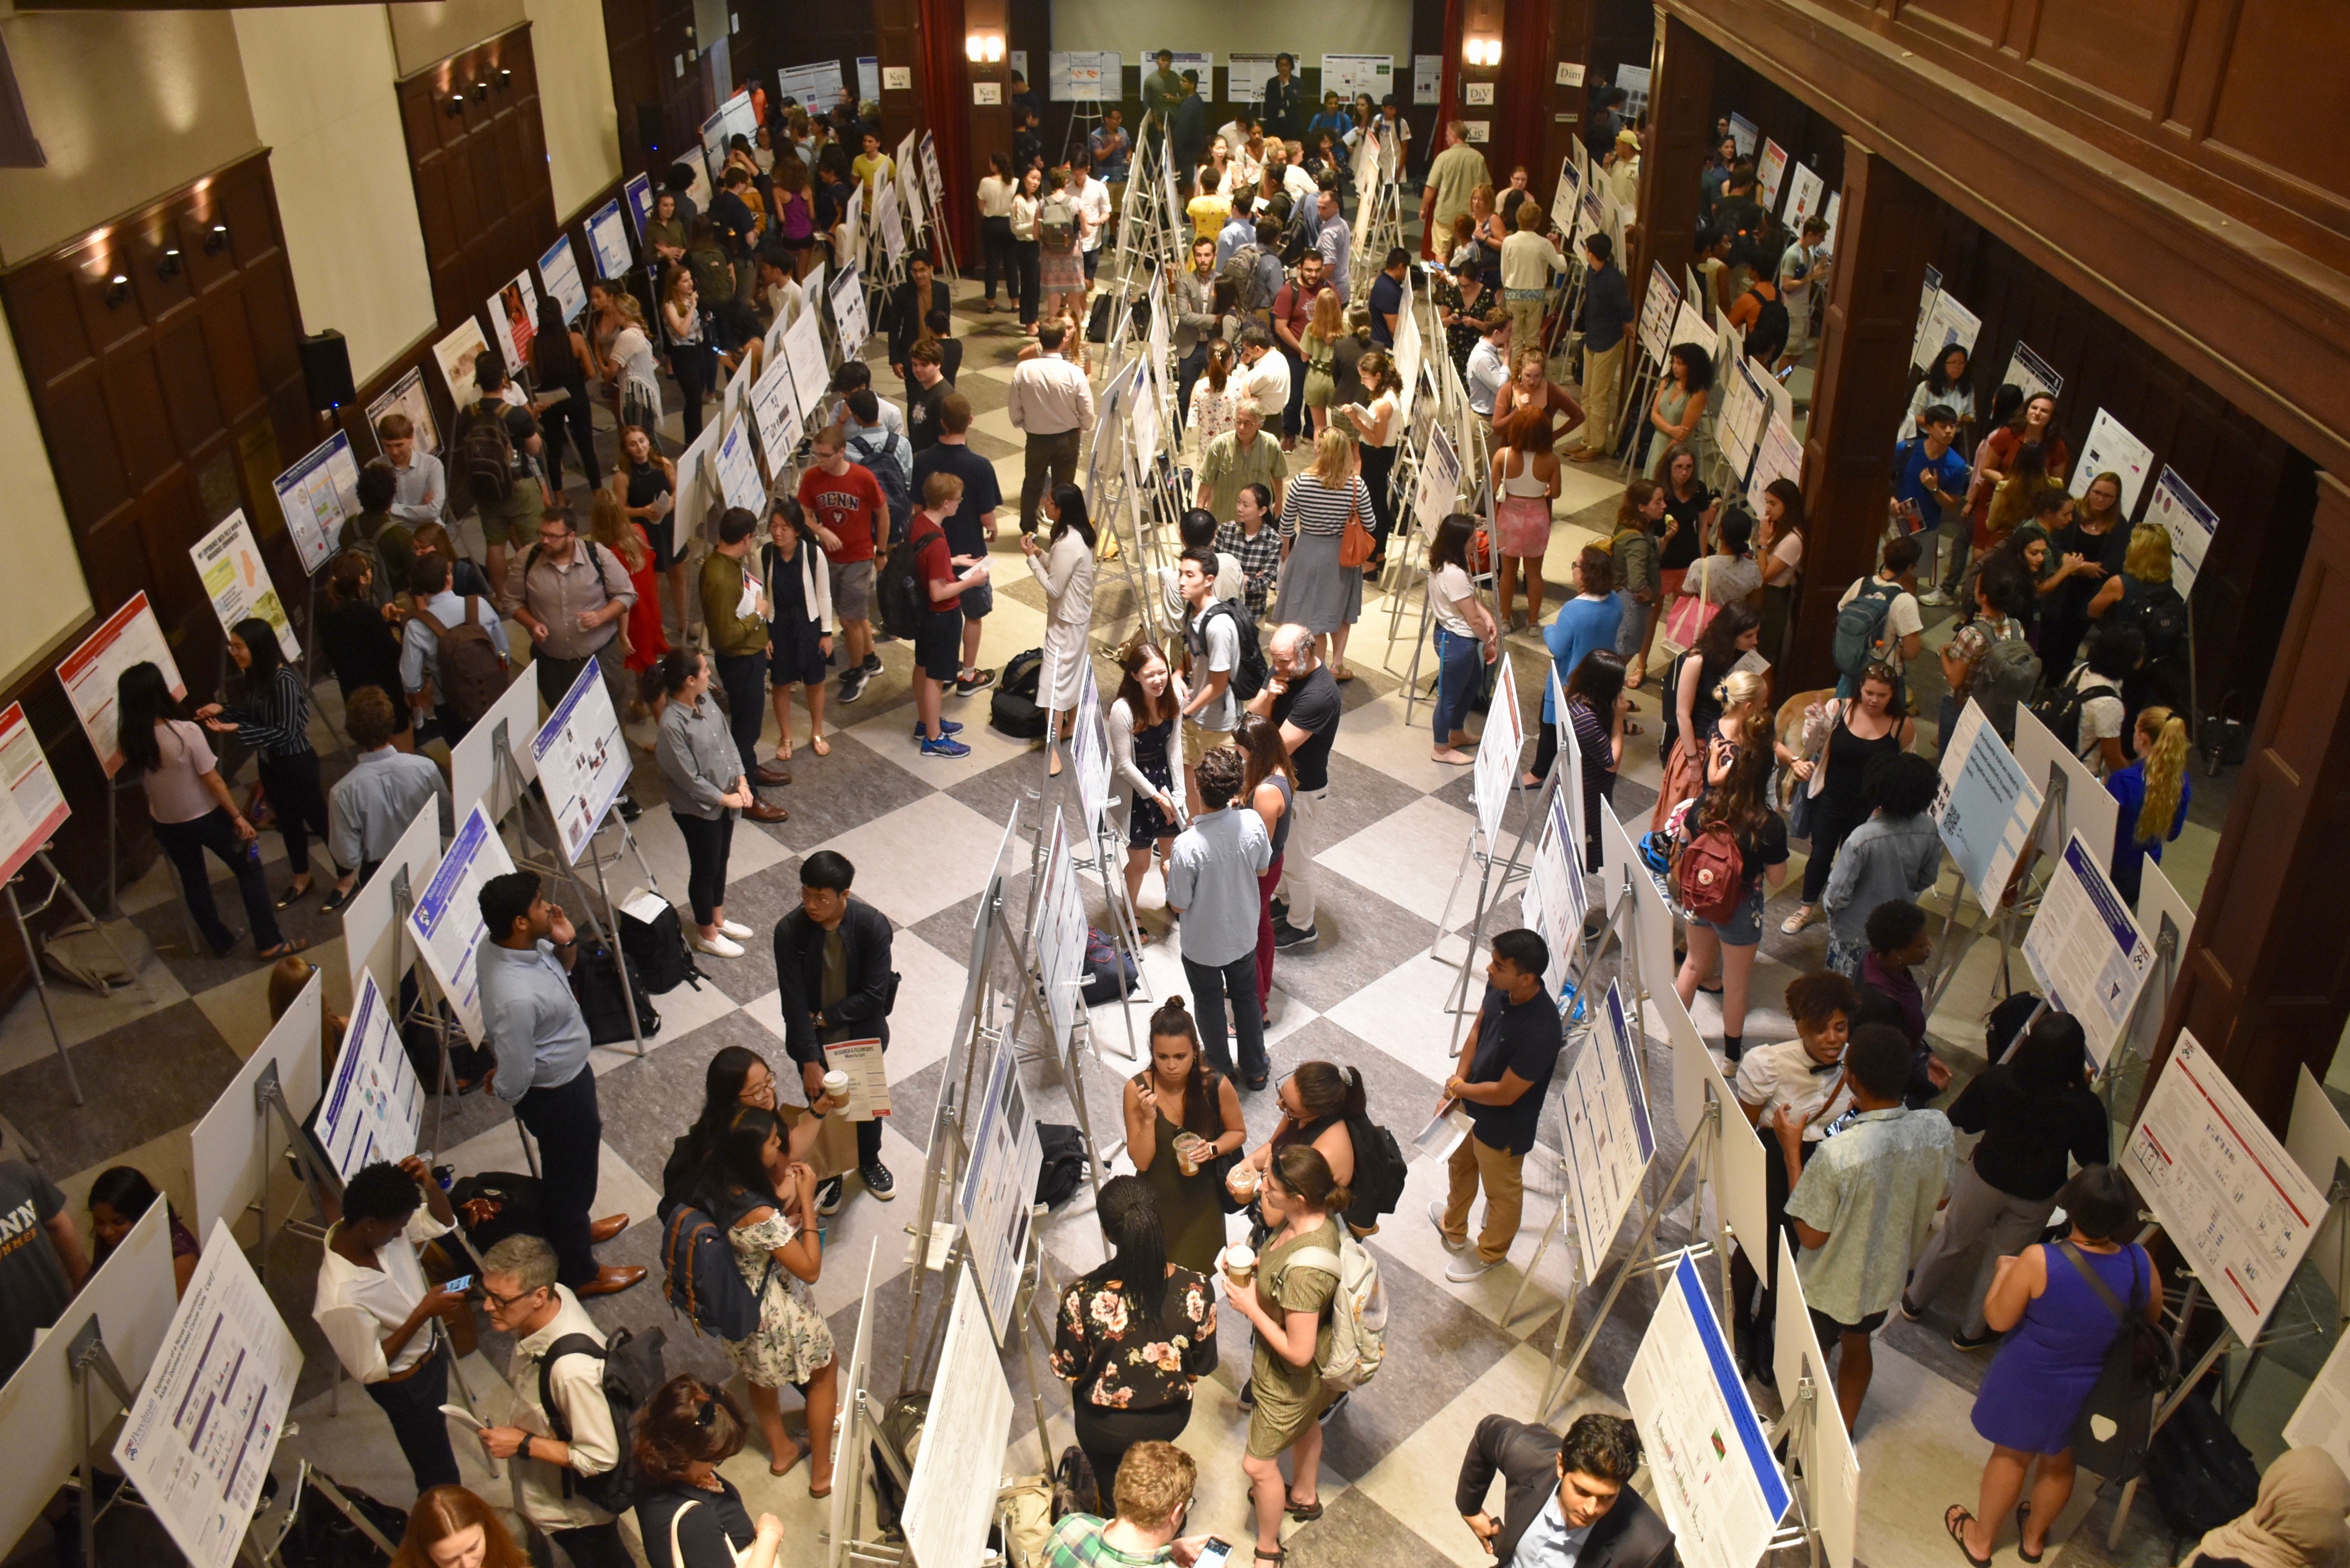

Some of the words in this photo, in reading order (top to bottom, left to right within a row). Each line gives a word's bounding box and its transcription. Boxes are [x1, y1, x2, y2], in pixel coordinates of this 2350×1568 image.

[1560, 68, 1580, 80] Dim
[979, 88, 996, 96] Ken
[816, 492, 859, 511] PENN
[1974, 760, 1985, 779] negative
[1975, 742, 1988, 764] decreased
[1986, 760, 2000, 782] sensitivity
[2001, 782, 2013, 802] positive
[1979, 731, 1996, 757] Psychopathic
[1995, 753, 2003, 767] traits
[2006, 769, 2016, 786] related
[2015, 783, 2020, 791] to
[0, 1199, 37, 1245] NN
[203, 1269, 216, 1293] curf
[153, 1356, 173, 1396] Exploration
[169, 1348, 174, 1359] of
[174, 1325, 185, 1346] Novel
[182, 1285, 203, 1329] Differentiation
[158, 1383, 167, 1401] Axis
[165, 1376, 171, 1385] in
[168, 1349, 183, 1378] Dormant
[179, 1328, 192, 1353] Breast
[189, 1308, 201, 1332] Cancer
[197, 1293, 207, 1311] Cells
[131, 1394, 155, 1443] Perelman
[1719, 1402, 1732, 1427] Analysis
